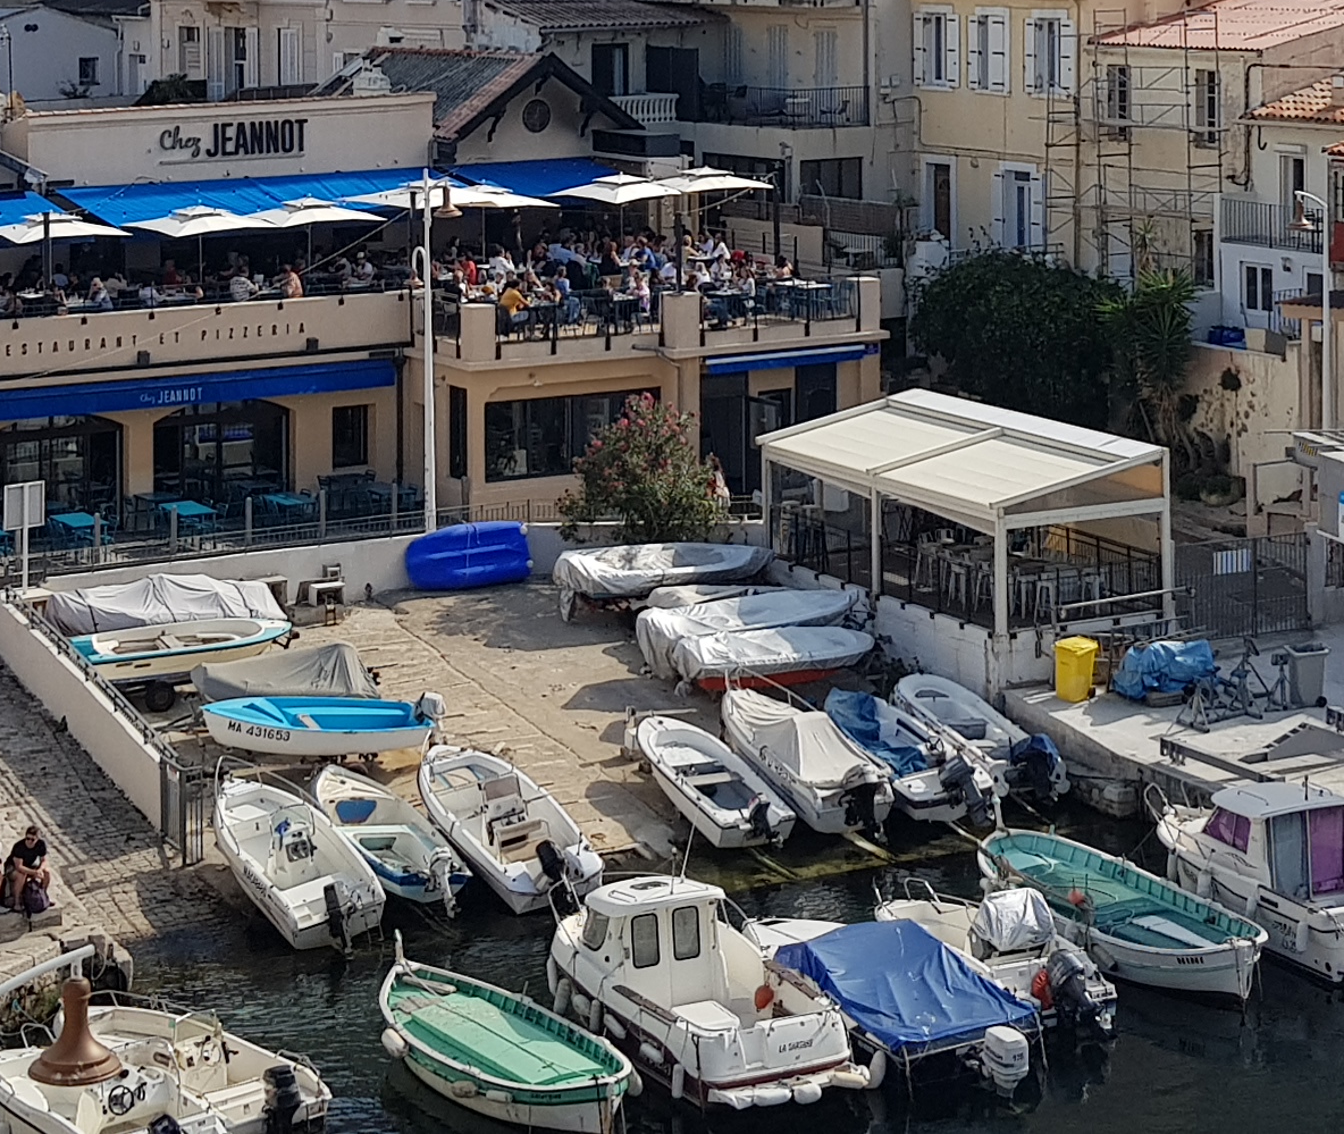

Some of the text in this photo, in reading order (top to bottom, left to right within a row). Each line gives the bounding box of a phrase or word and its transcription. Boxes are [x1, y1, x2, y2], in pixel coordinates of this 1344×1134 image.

[159, 119, 308, 158] Chez JEANNOT
[159, 331, 180, 345] ET
[201, 322, 306, 342] PIZZERIA
[157, 387, 202, 404] JEANNOT
[227, 720, 242, 733] MA
